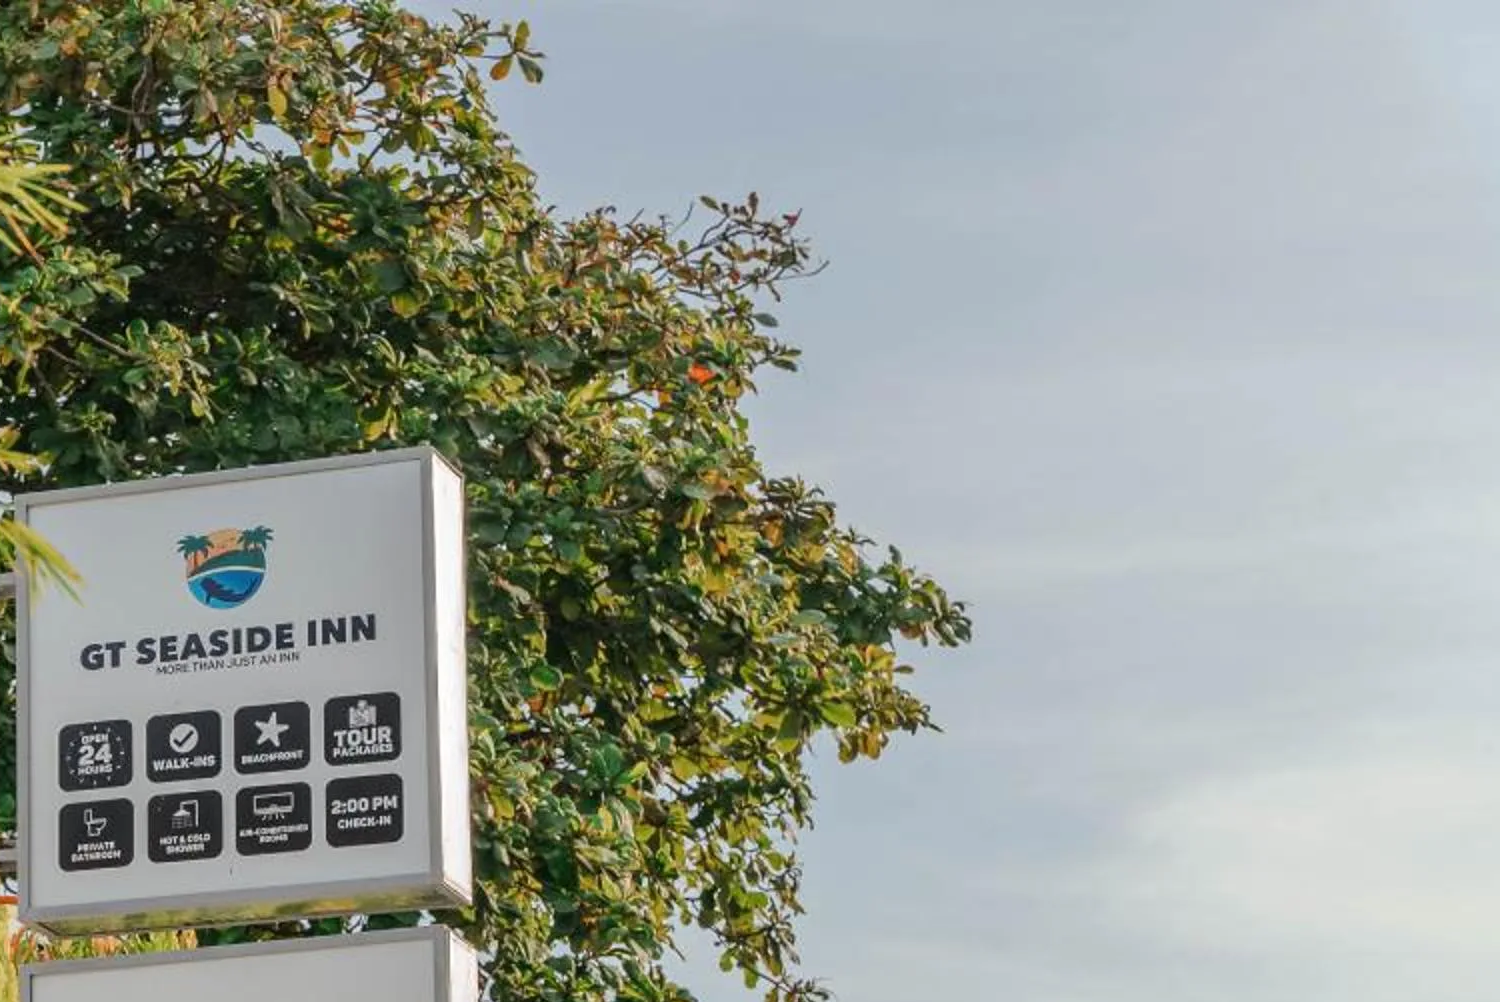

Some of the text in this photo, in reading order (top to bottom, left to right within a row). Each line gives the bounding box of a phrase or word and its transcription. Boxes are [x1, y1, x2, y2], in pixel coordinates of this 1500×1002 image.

[80, 614, 376, 671] GT SEASIDE INN
[156, 652, 299, 675] MORE THAN JUST AN INN
[81, 734, 109, 745] OPEN
[333, 726, 393, 747] TOUR
[79, 743, 112, 766] 24
[333, 743, 393, 758] PACKAGES
[78, 764, 113, 776] HOURS
[153, 755, 216, 771] WALK-INS
[331, 795, 398, 815] 2:00 PM
[337, 816, 392, 829] CHECK-IN
